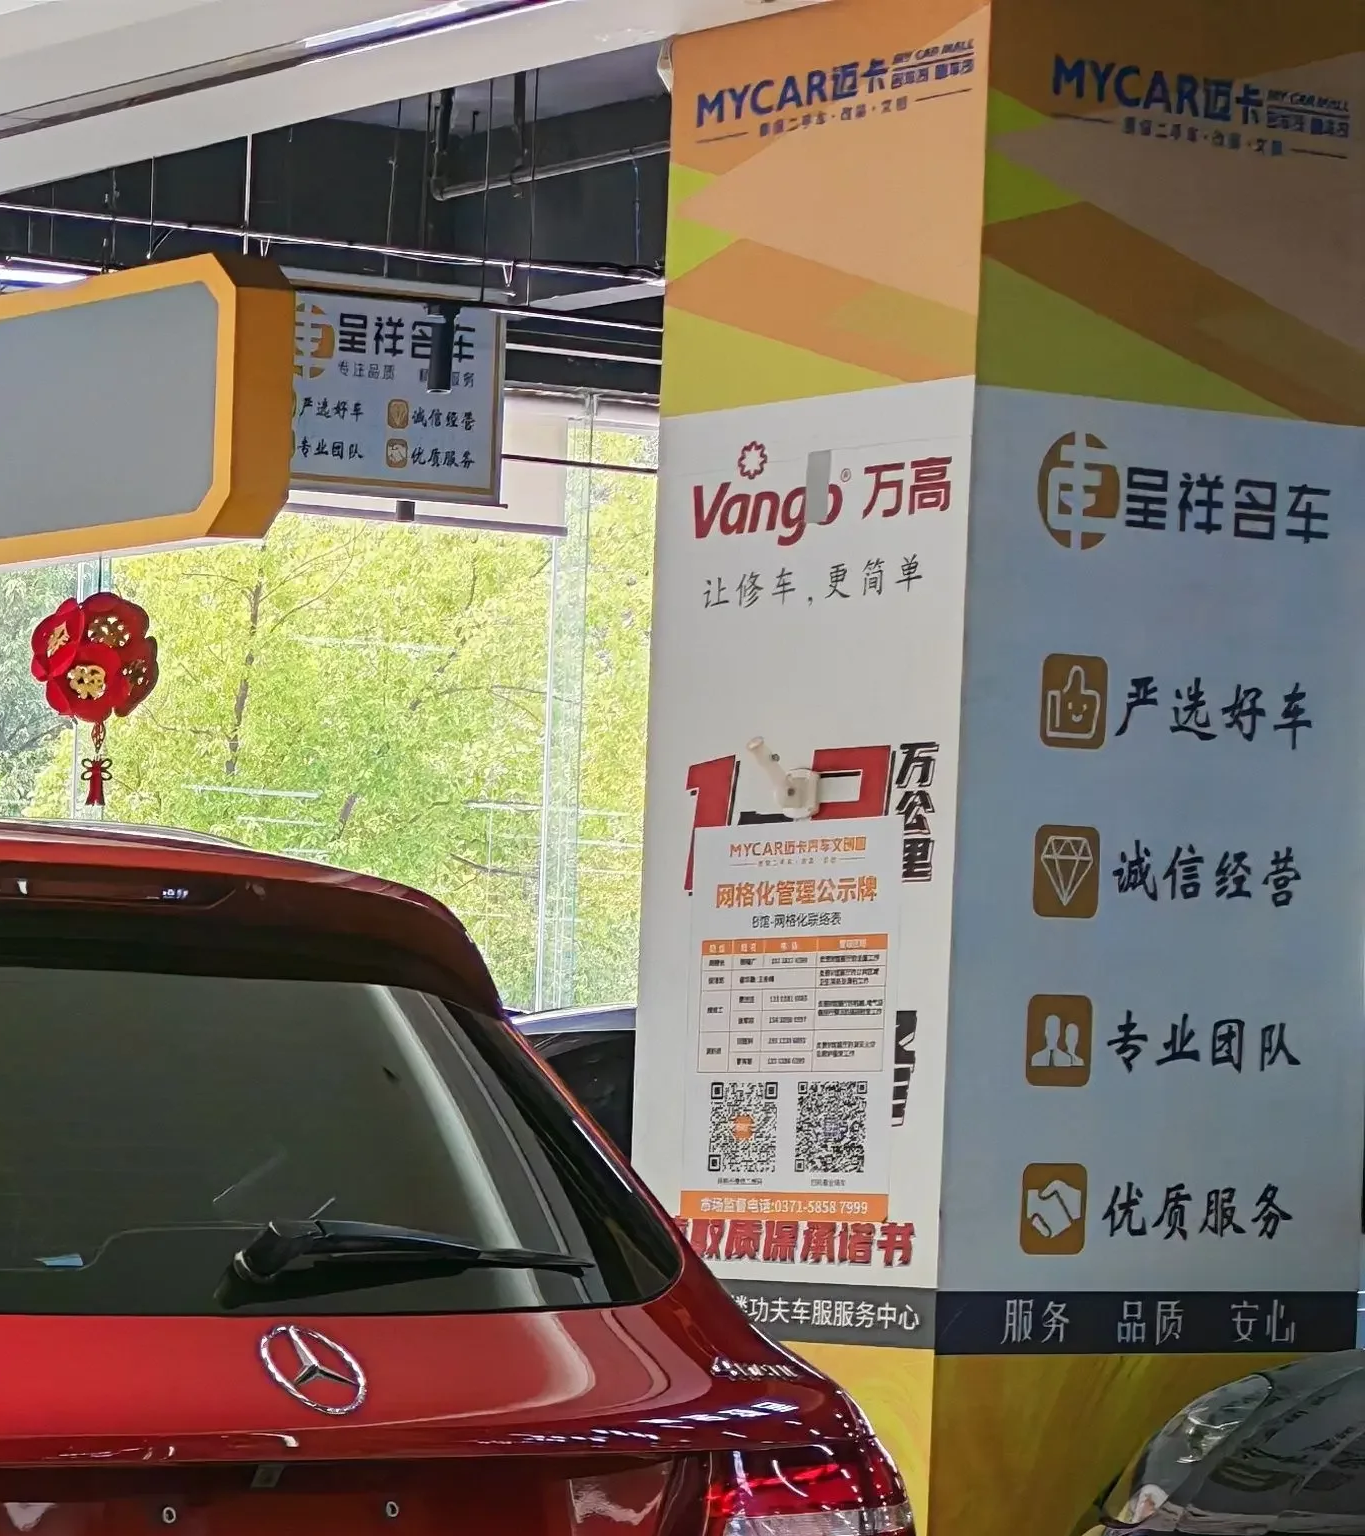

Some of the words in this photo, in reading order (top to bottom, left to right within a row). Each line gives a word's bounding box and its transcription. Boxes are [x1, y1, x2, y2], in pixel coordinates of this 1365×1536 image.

[696, 58, 888, 128] MYCAR迈卡
[1052, 54, 1264, 124] MYCAR迈卡
[299, 397, 365, 423] 严选好车
[412, 406, 476, 431] 诚信经营
[297, 436, 365, 460] 专业团队
[411, 446, 476, 469] 优质服务
[861, 456, 953, 519] 万高
[1125, 466, 1331, 543] 呈祥名车
[1114, 676, 1312, 750] 严选好车
[895, 741, 939, 882] 万公里
[716, 876, 877, 908] 网格化管理公示牌
[1112, 839, 1302, 907] 诚信经营
[1107, 1010, 1301, 1072] 专业团队
[1101, 1182, 1294, 1240] 优质服务
[1001, 1299, 1070, 1344] 服务
[1117, 1302, 1184, 1345] 品质
[1230, 1301, 1296, 1344] 安心
